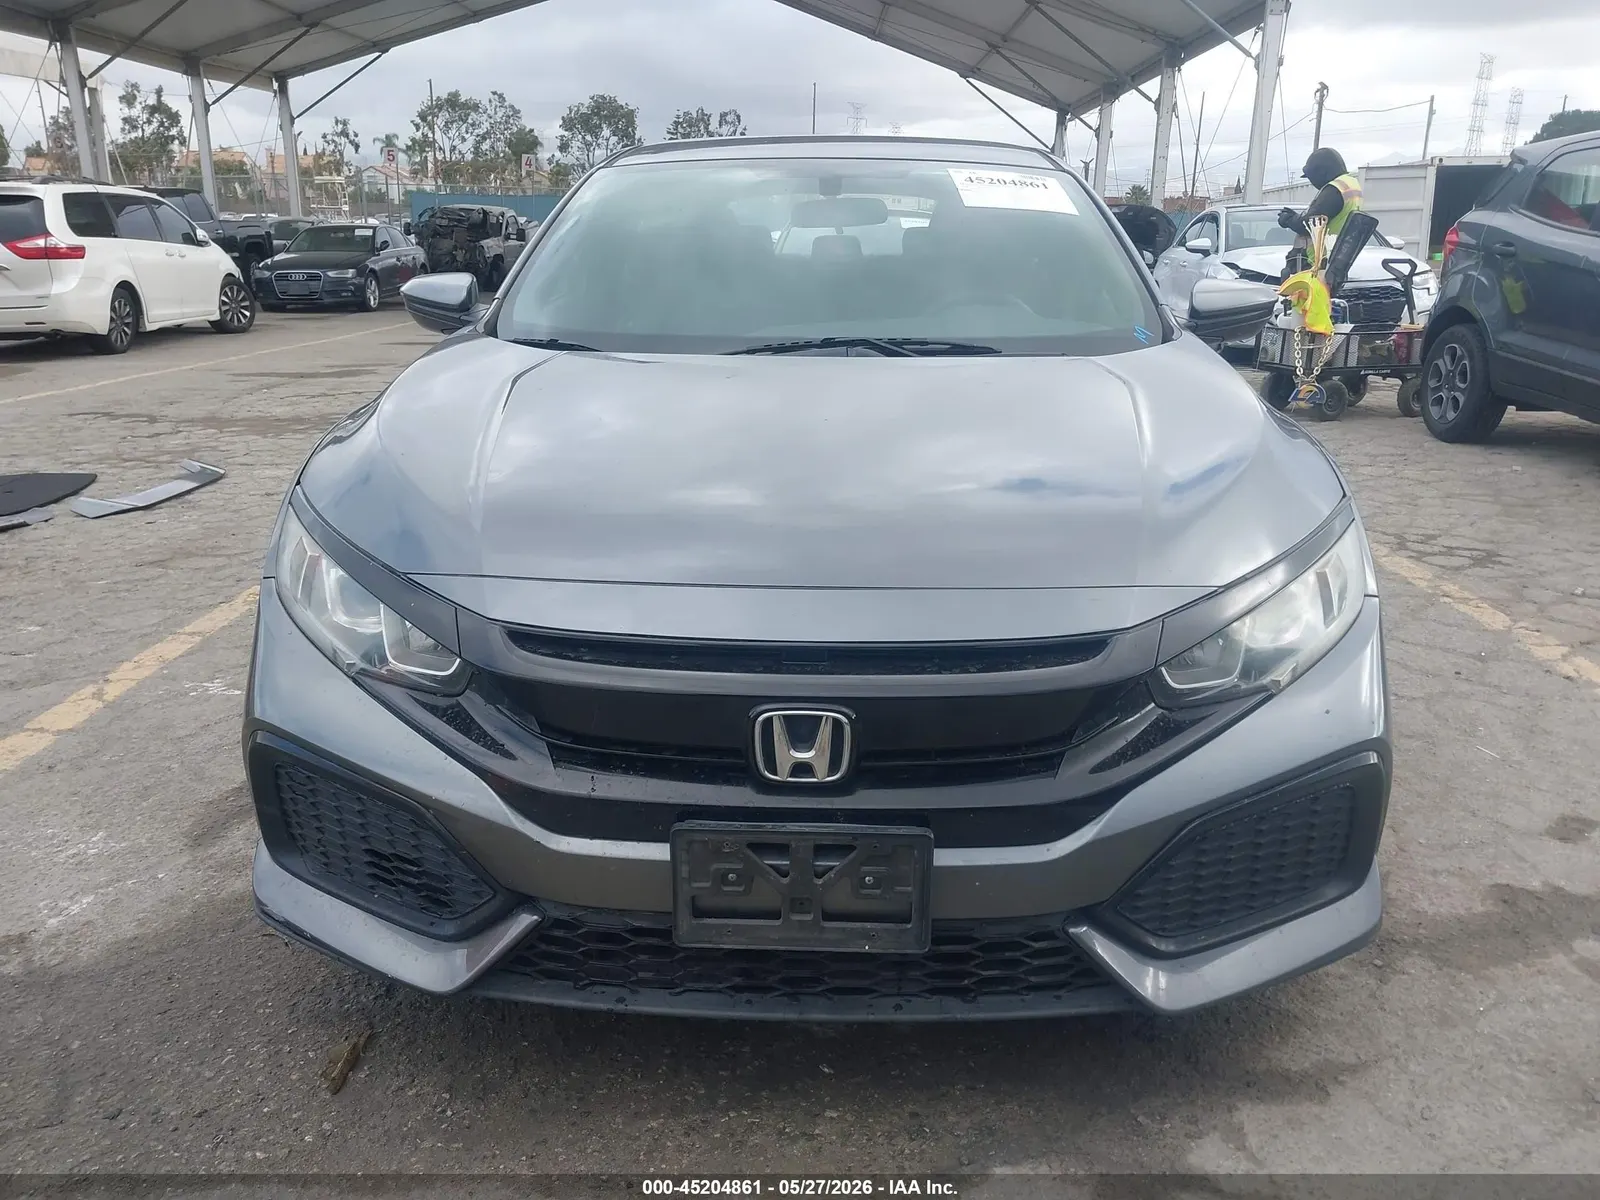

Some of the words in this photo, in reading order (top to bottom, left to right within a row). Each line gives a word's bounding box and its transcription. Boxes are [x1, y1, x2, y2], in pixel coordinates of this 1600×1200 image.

[387, 149, 395, 162] 5
[524, 156, 533, 169] 4
[964, 176, 1048, 189] 45204861
